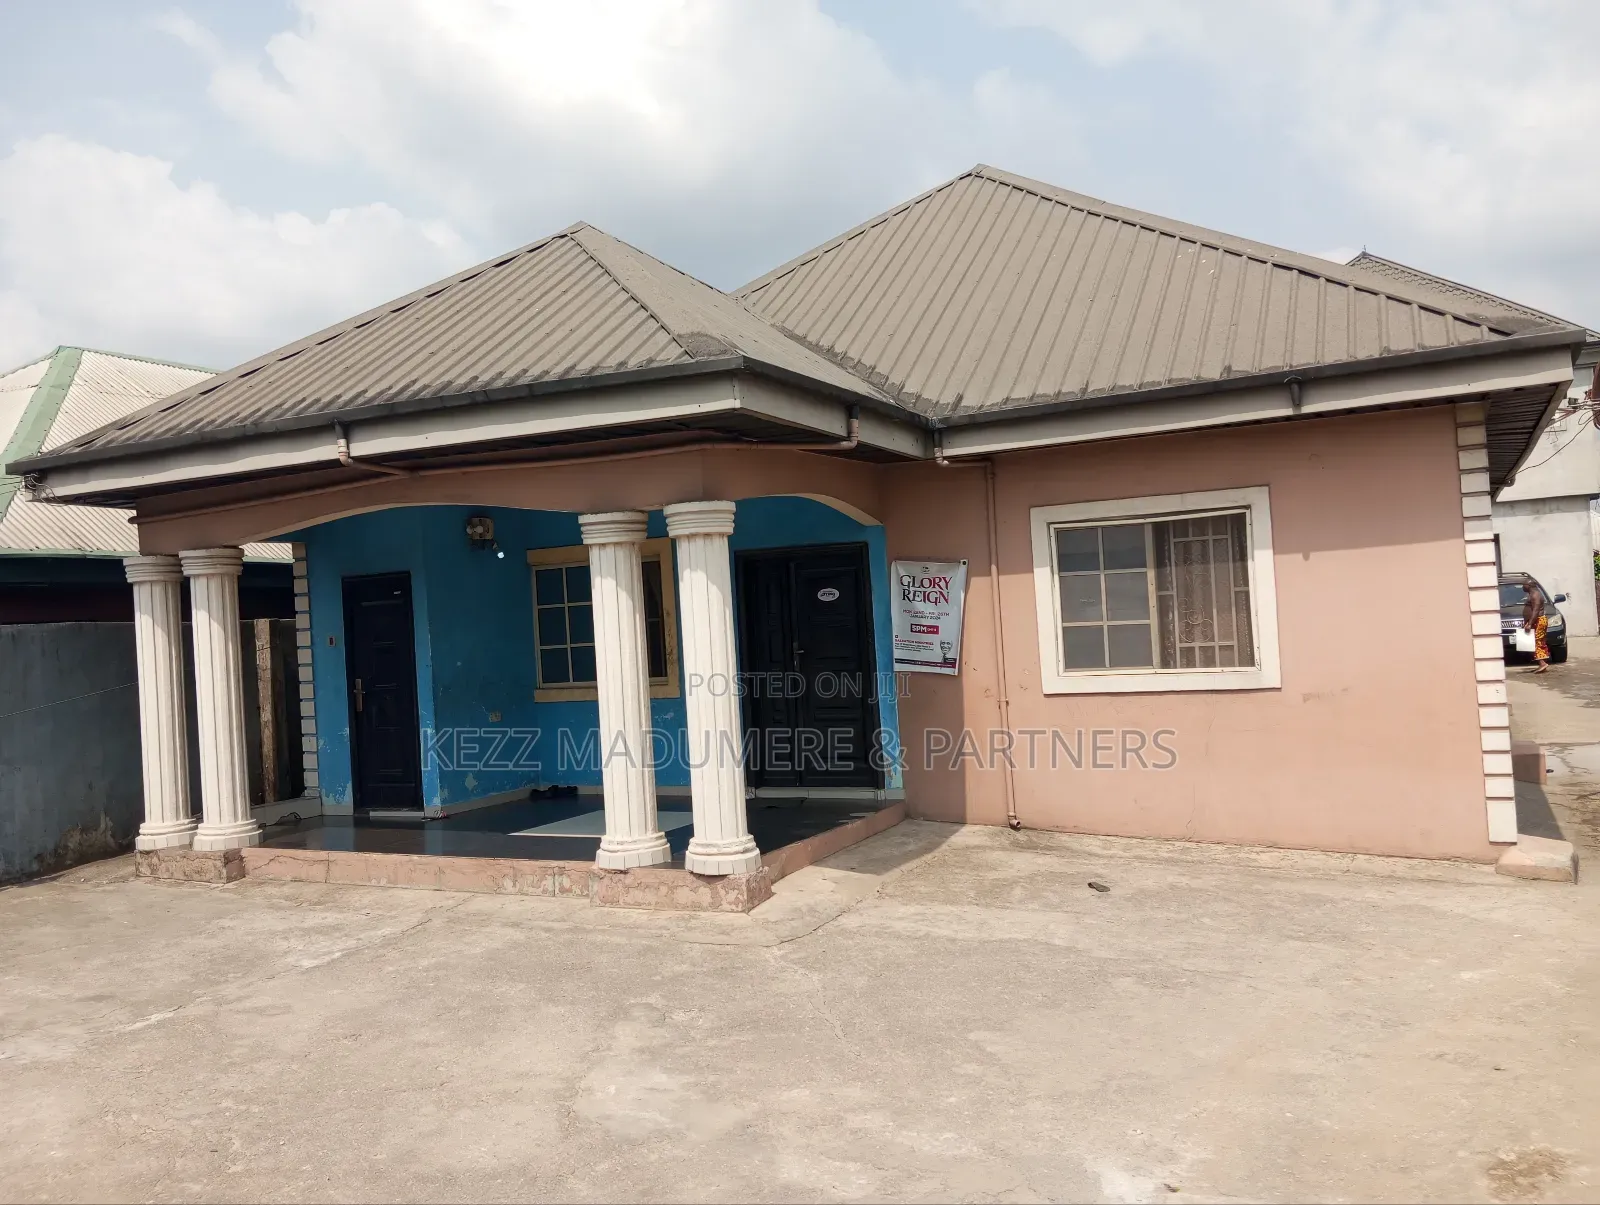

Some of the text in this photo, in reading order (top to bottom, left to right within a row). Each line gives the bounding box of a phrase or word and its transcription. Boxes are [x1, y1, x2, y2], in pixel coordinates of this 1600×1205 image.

[900, 574, 952, 590] GLORY
[902, 589, 950, 606] REIGN
[912, 624, 927, 632] 5PM
